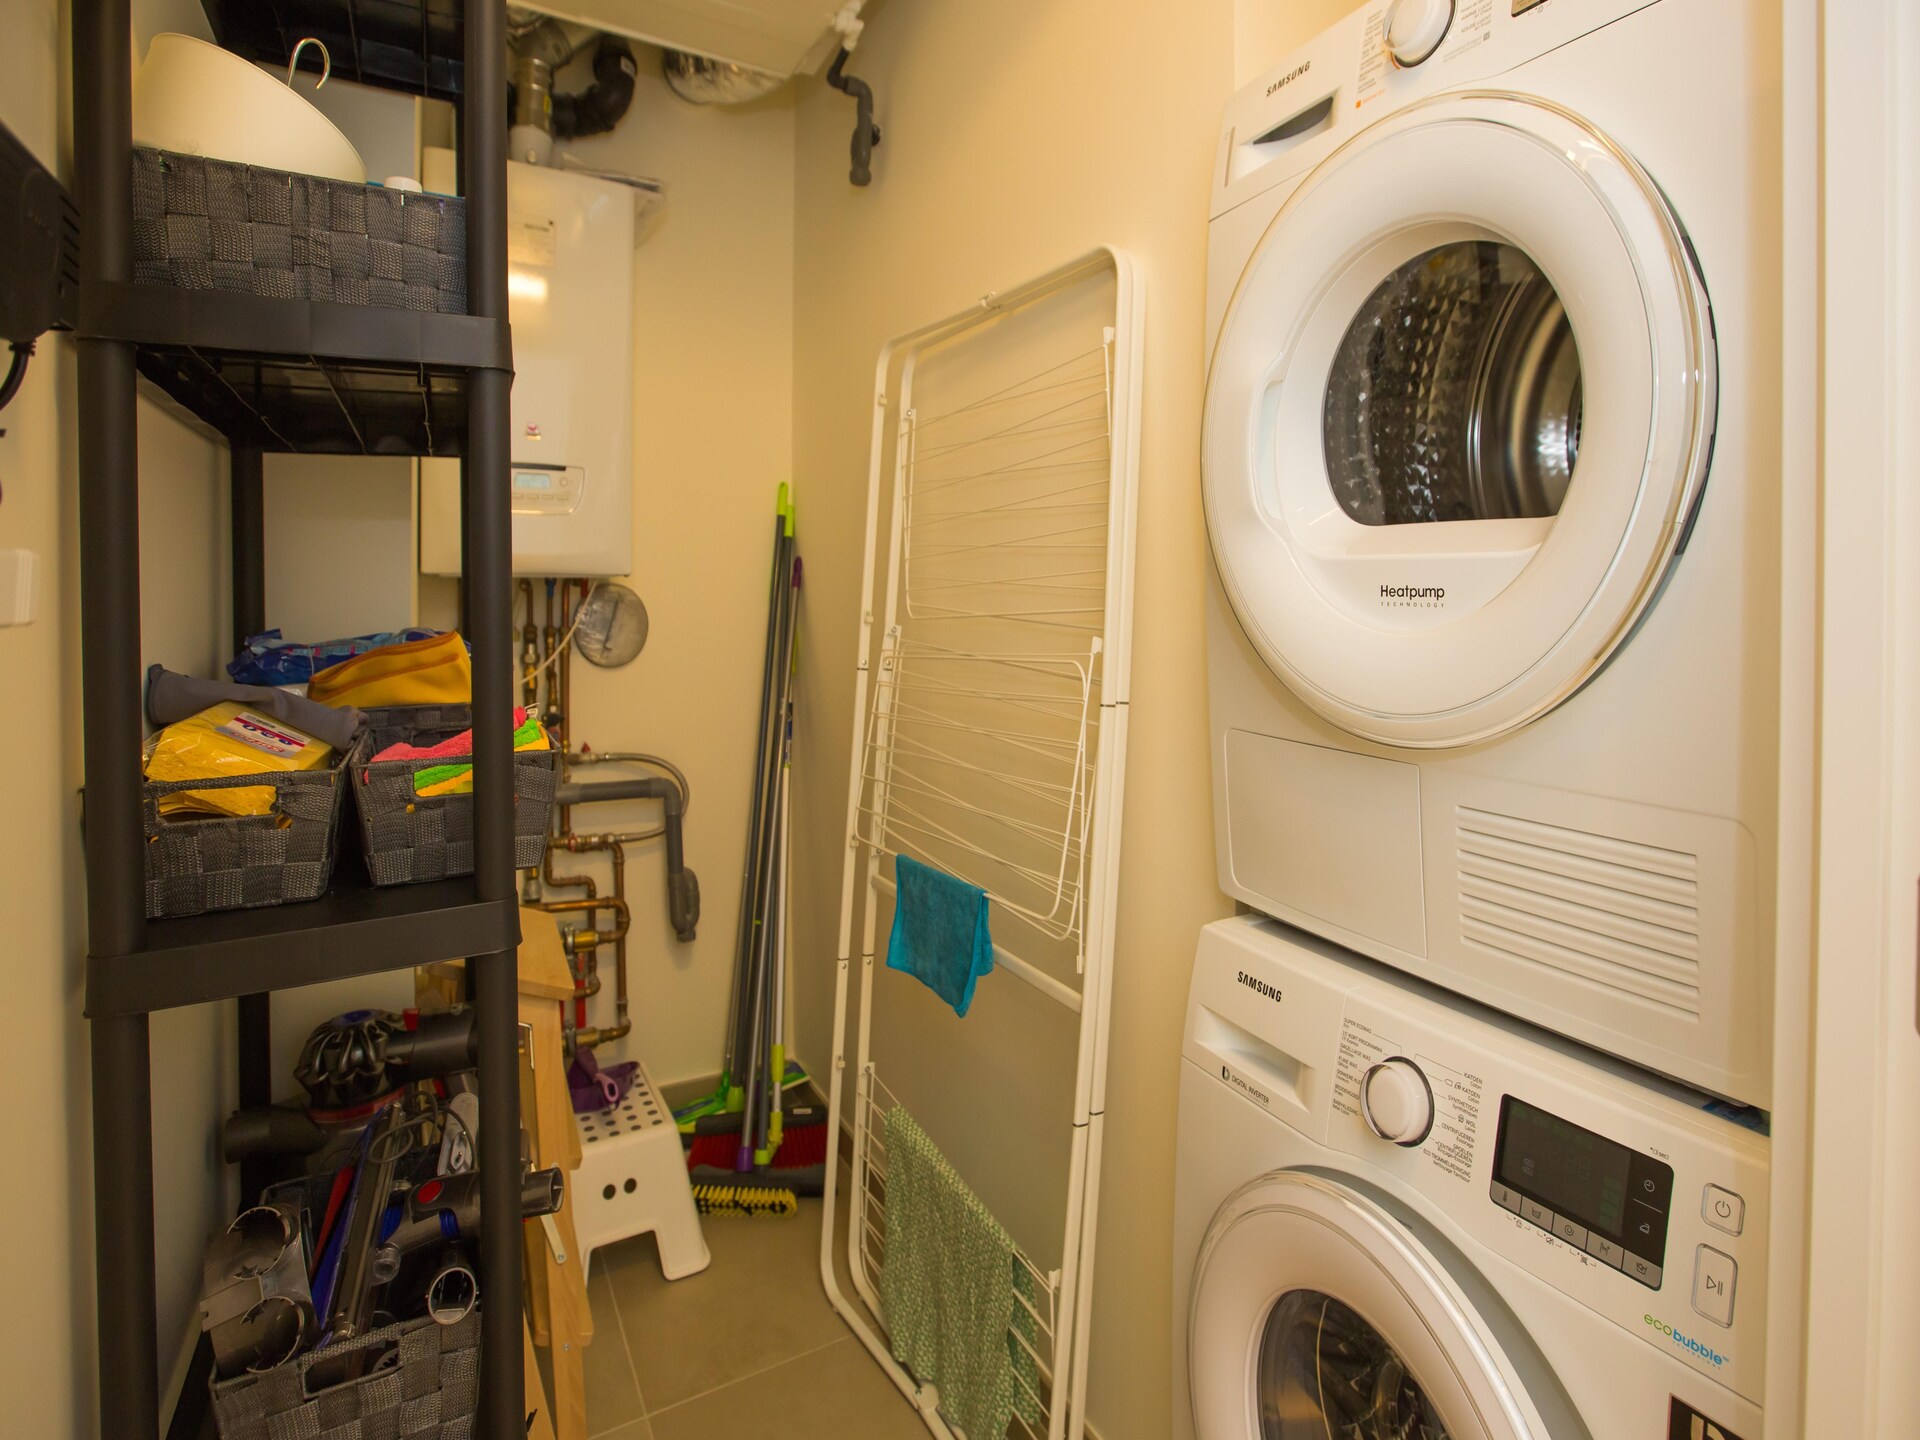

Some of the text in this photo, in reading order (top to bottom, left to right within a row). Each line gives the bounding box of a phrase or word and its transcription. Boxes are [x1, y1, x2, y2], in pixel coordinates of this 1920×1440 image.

[1266, 60, 1311, 97] SAMSUNG
[1381, 585, 1445, 601] Heatpump
[1238, 971, 1282, 1002] SAMSUNG
[1464, 1072, 1483, 1084] KATOEN
[1470, 1081, 1482, 1090] Coton
[1231, 1075, 1248, 1090] DIGITAL
[1249, 1086, 1269, 1103] INVERTER
[1462, 1087, 1480, 1099] KATOEN
[1448, 1094, 1478, 1113] SYNTHETISCH
[1468, 1096, 1479, 1104] Coton
[1466, 1119, 1476, 1128] WOL
[1441, 1122, 1475, 1143] CENTRIFUGEREN
[1453, 1144, 1473, 1157] SPOELEN
[1456, 1136, 1474, 1149] Essorage
[1423, 1148, 1471, 1178] ECO TROMMELREINIGING
[1644, 1314, 1722, 1366] ecobubble
